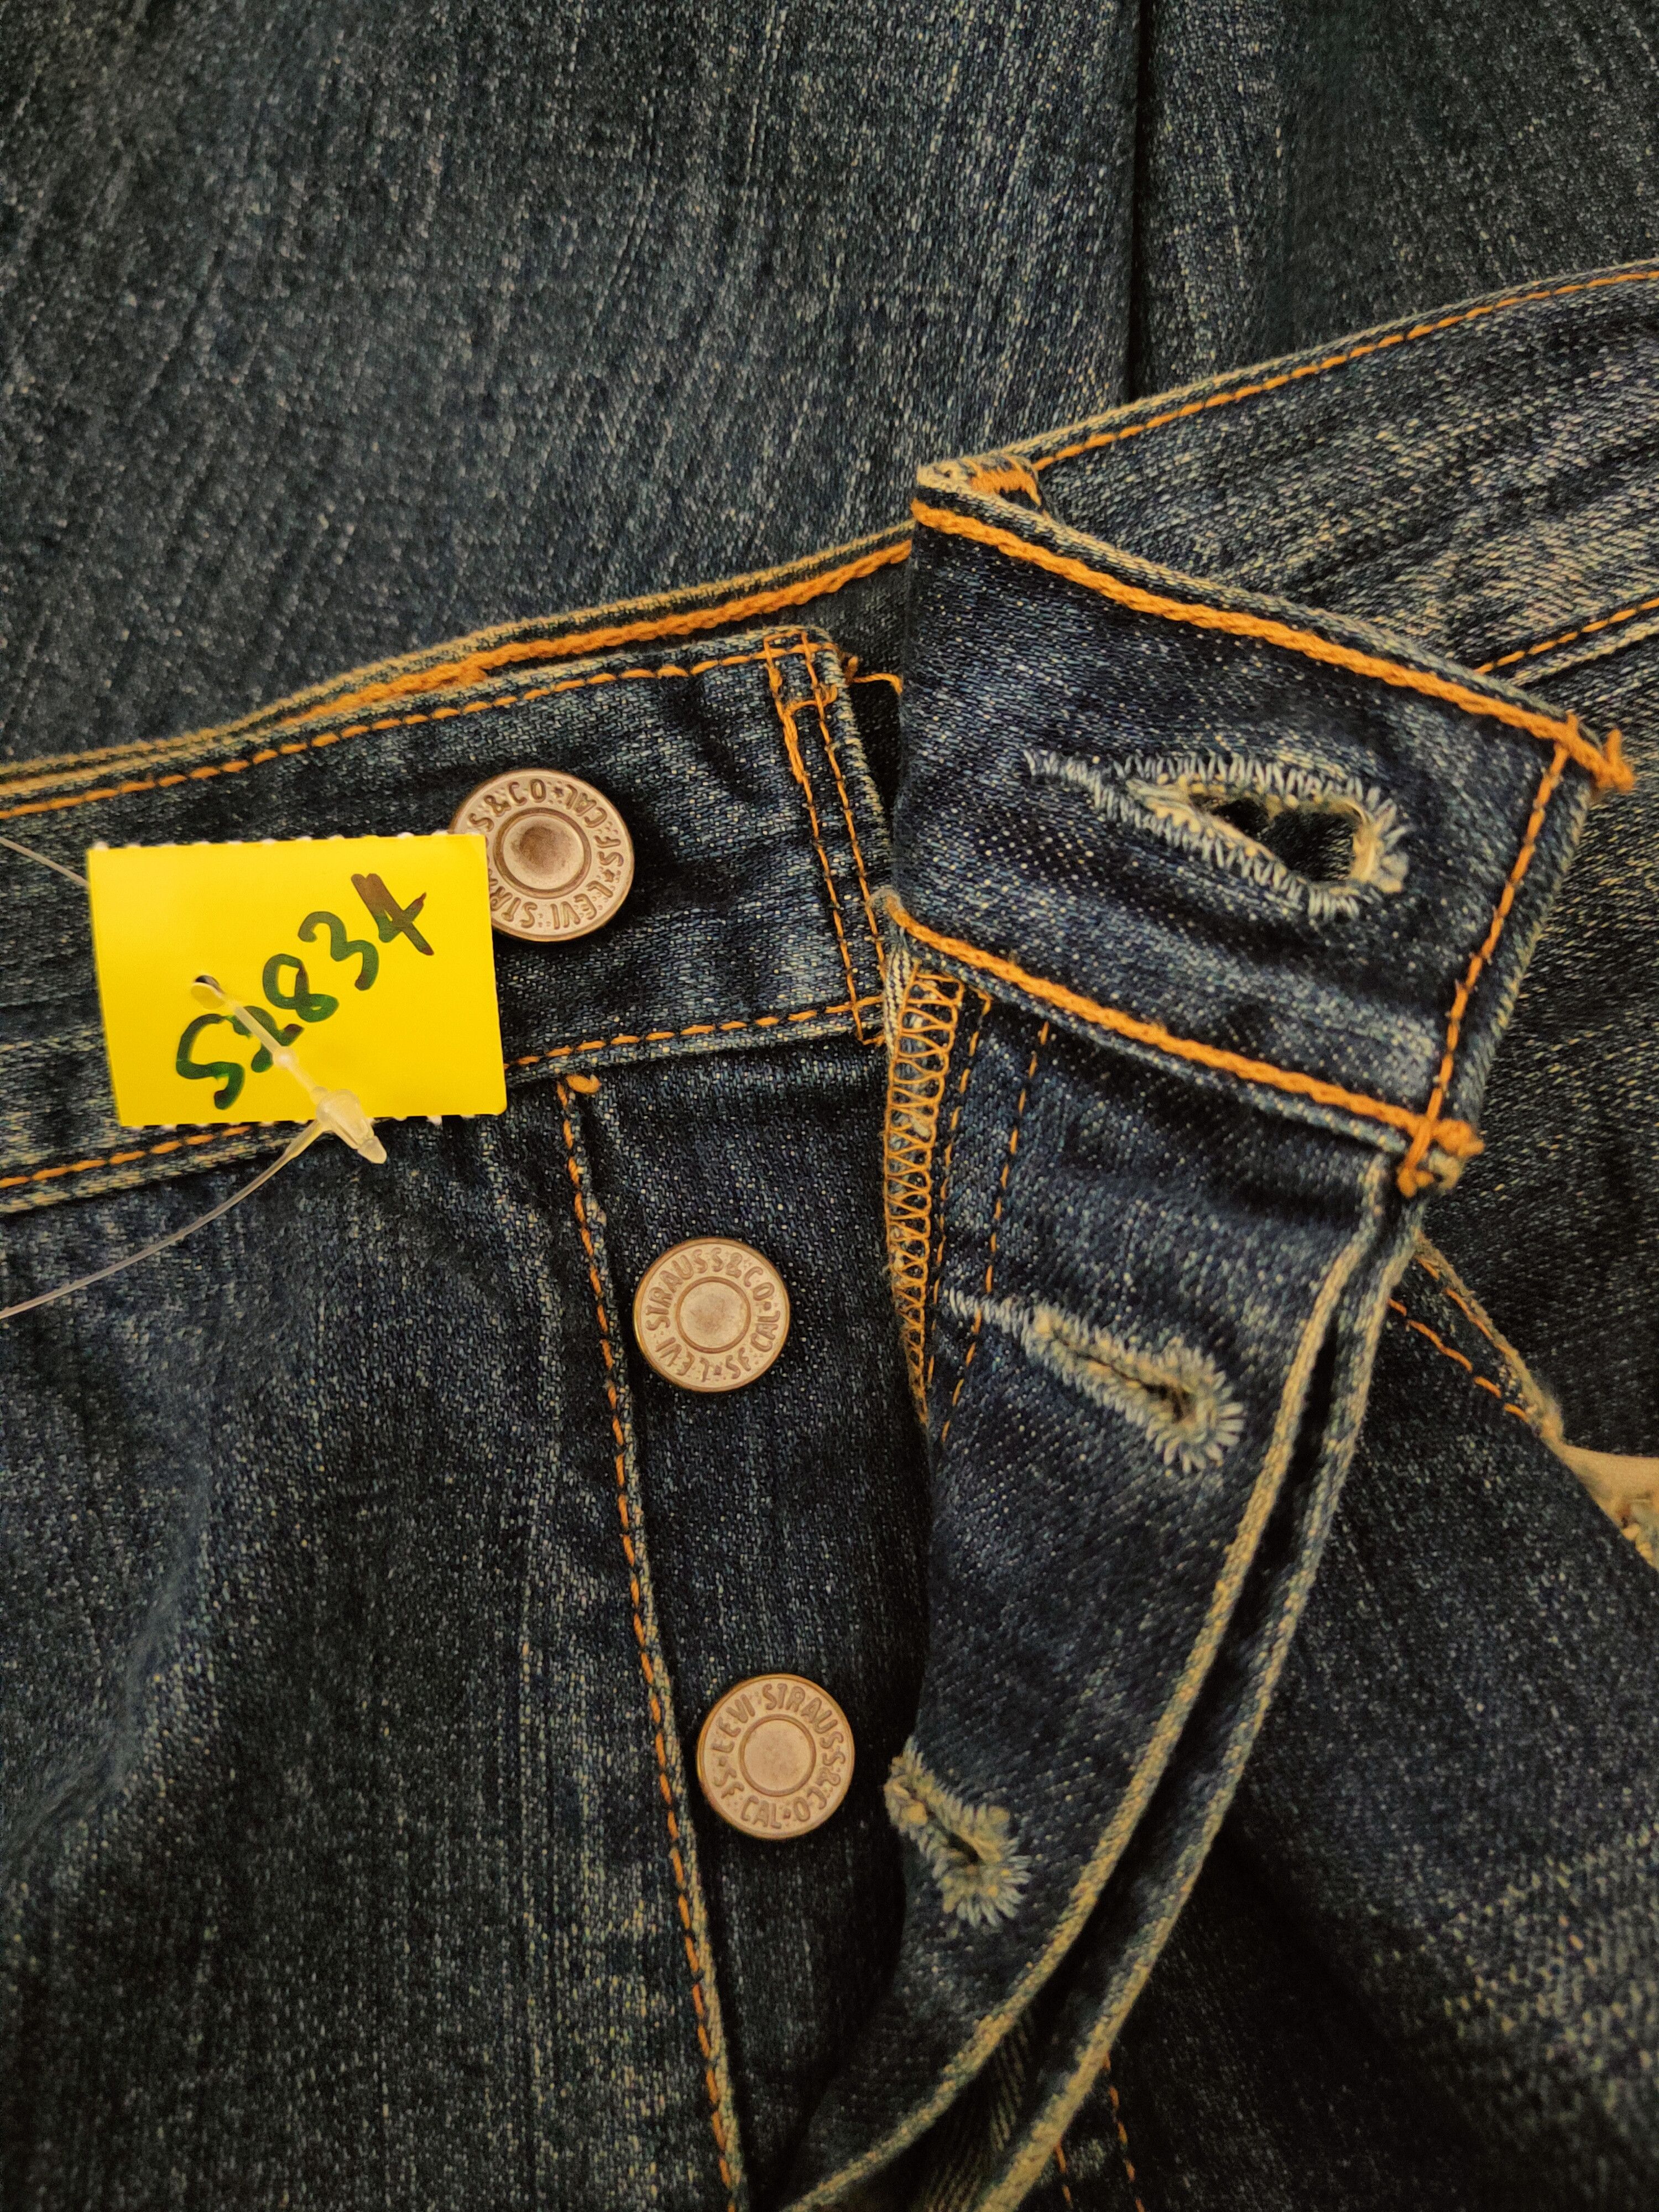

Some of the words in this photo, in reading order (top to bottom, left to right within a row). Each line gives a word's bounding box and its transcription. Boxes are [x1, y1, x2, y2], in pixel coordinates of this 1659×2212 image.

[565, 784, 608, 828] CAL
[550, 880, 613, 930] LEVI
[645, 1247, 724, 1331] STRAUSS
[750, 1310, 781, 1353] CAL
[655, 1337, 709, 1383] LEVI
[712, 1694, 755, 1754] LEVI
[761, 1683, 846, 1766] STRAUSS
[740, 1795, 781, 1829] CAL
